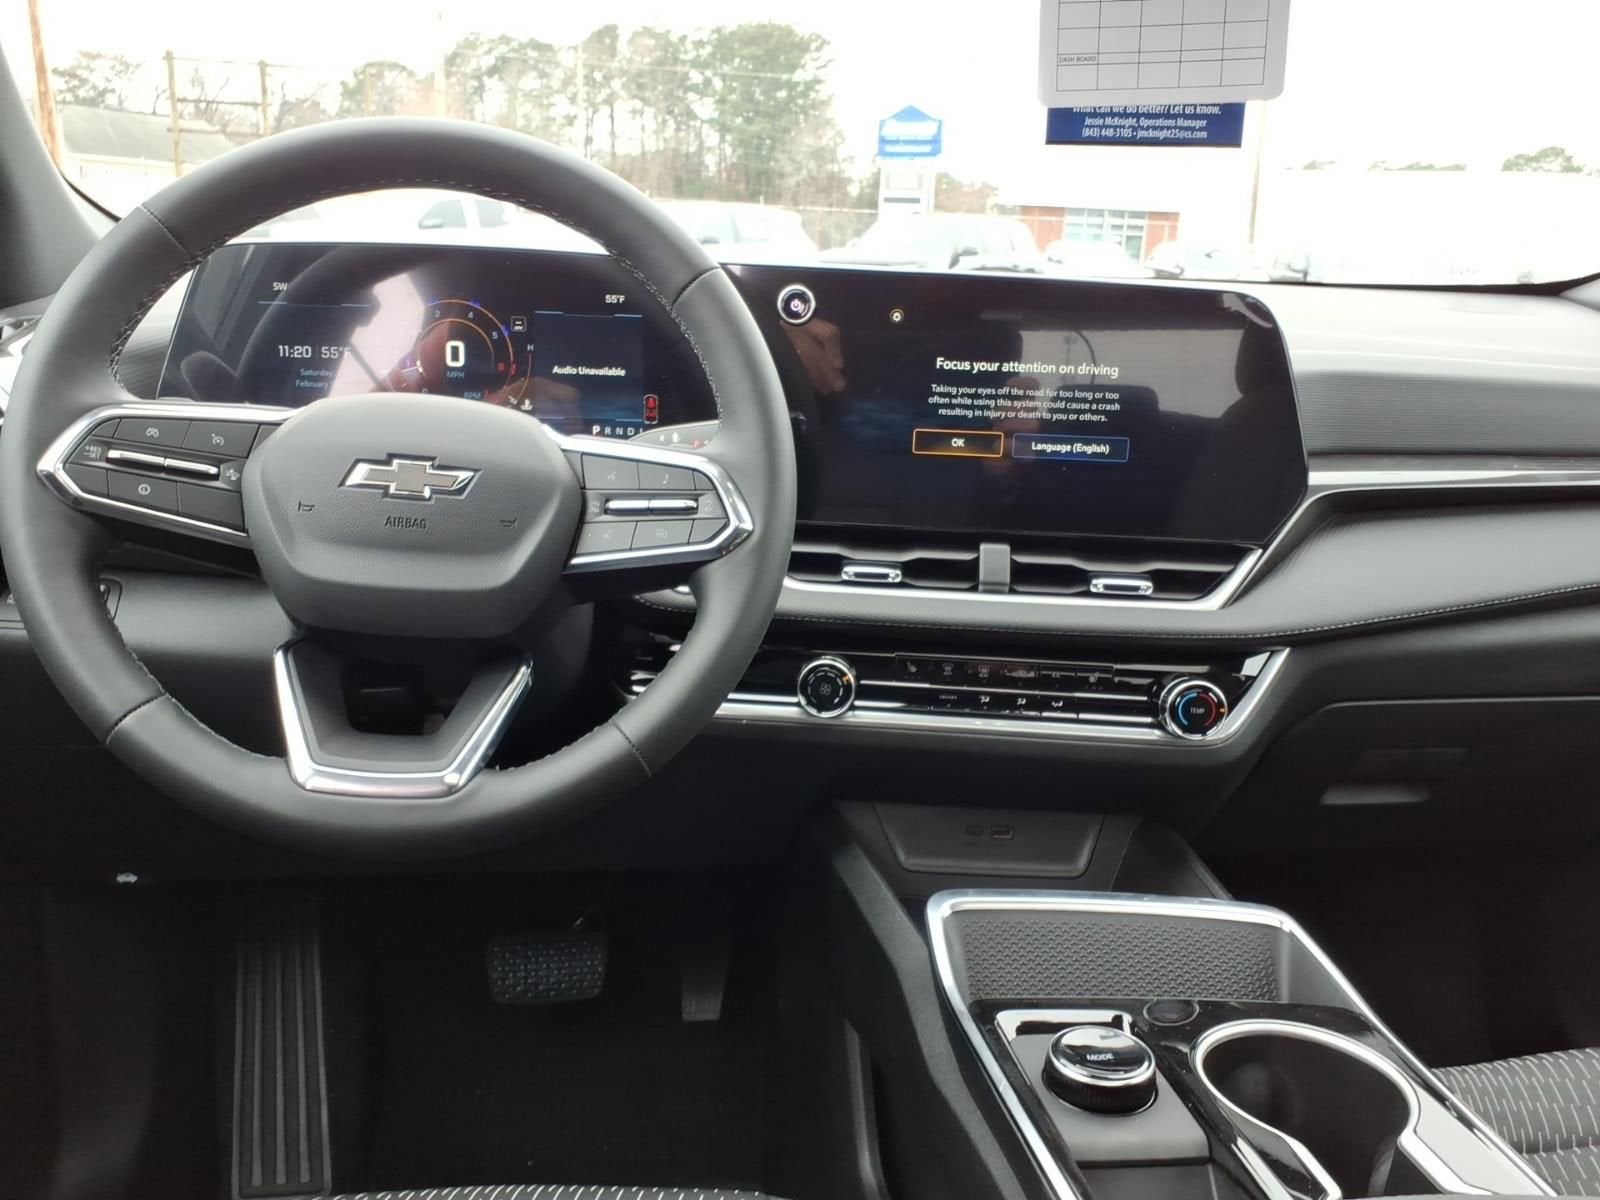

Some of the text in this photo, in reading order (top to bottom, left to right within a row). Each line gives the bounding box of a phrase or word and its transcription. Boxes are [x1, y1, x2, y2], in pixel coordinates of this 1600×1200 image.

[1096, 105, 1110, 113] can
[1139, 104, 1168, 114] better?
[1171, 104, 1183, 114] Let
[1185, 105, 1194, 114] us
[1196, 104, 1221, 115] know.
[1084, 117, 1207, 128] Jessie McKnight, Operations Manager
[1082, 128, 1100, 138] (843)
[1101, 128, 1132, 137] 448-3105
[273, 282, 287, 291] SW
[605, 295, 625, 303] 55°F
[278, 345, 312, 358] 11:20
[446, 340, 465, 367] 0
[300, 369, 333, 377] Saturday
[552, 366, 626, 376] Audio Unavailable
[936, 358, 1119, 379] Focus your attention on driving
[296, 380, 328, 389] February
[931, 385, 957, 395] Taking
[959, 387, 976, 396] your
[978, 387, 996, 396] eyes
[997, 386, 1010, 395] off
[1011, 388, 1024, 396] the
[1026, 388, 1044, 397] road
[1046, 388, 1058, 397] for
[1060, 389, 1073, 397] too
[1075, 390, 1092, 400] long
[1105, 391, 1119, 399] too
[928, 396, 950, 404] often
[951, 397, 972, 405] while
[974, 398, 995, 408] using
[997, 399, 1012, 407] this
[1013, 400, 1041, 409] system
[1043, 400, 1065, 409] could
[1067, 402, 1089, 410] cause
[1098, 402, 1120, 411] crash
[938, 408, 973, 418] resulting
[974, 409, 982, 417] in
[984, 409, 1006, 419] injury
[1018, 410, 1041, 419] death
[1052, 413, 1068, 422] you
[1079, 413, 1108, 422] others.
[592, 426, 600, 434] P
[952, 439, 964, 447] OK
[1032, 442, 1109, 455] Language (English)
[384, 515, 427, 530] AIRBAG
[1086, 1053, 1114, 1061] MODE
